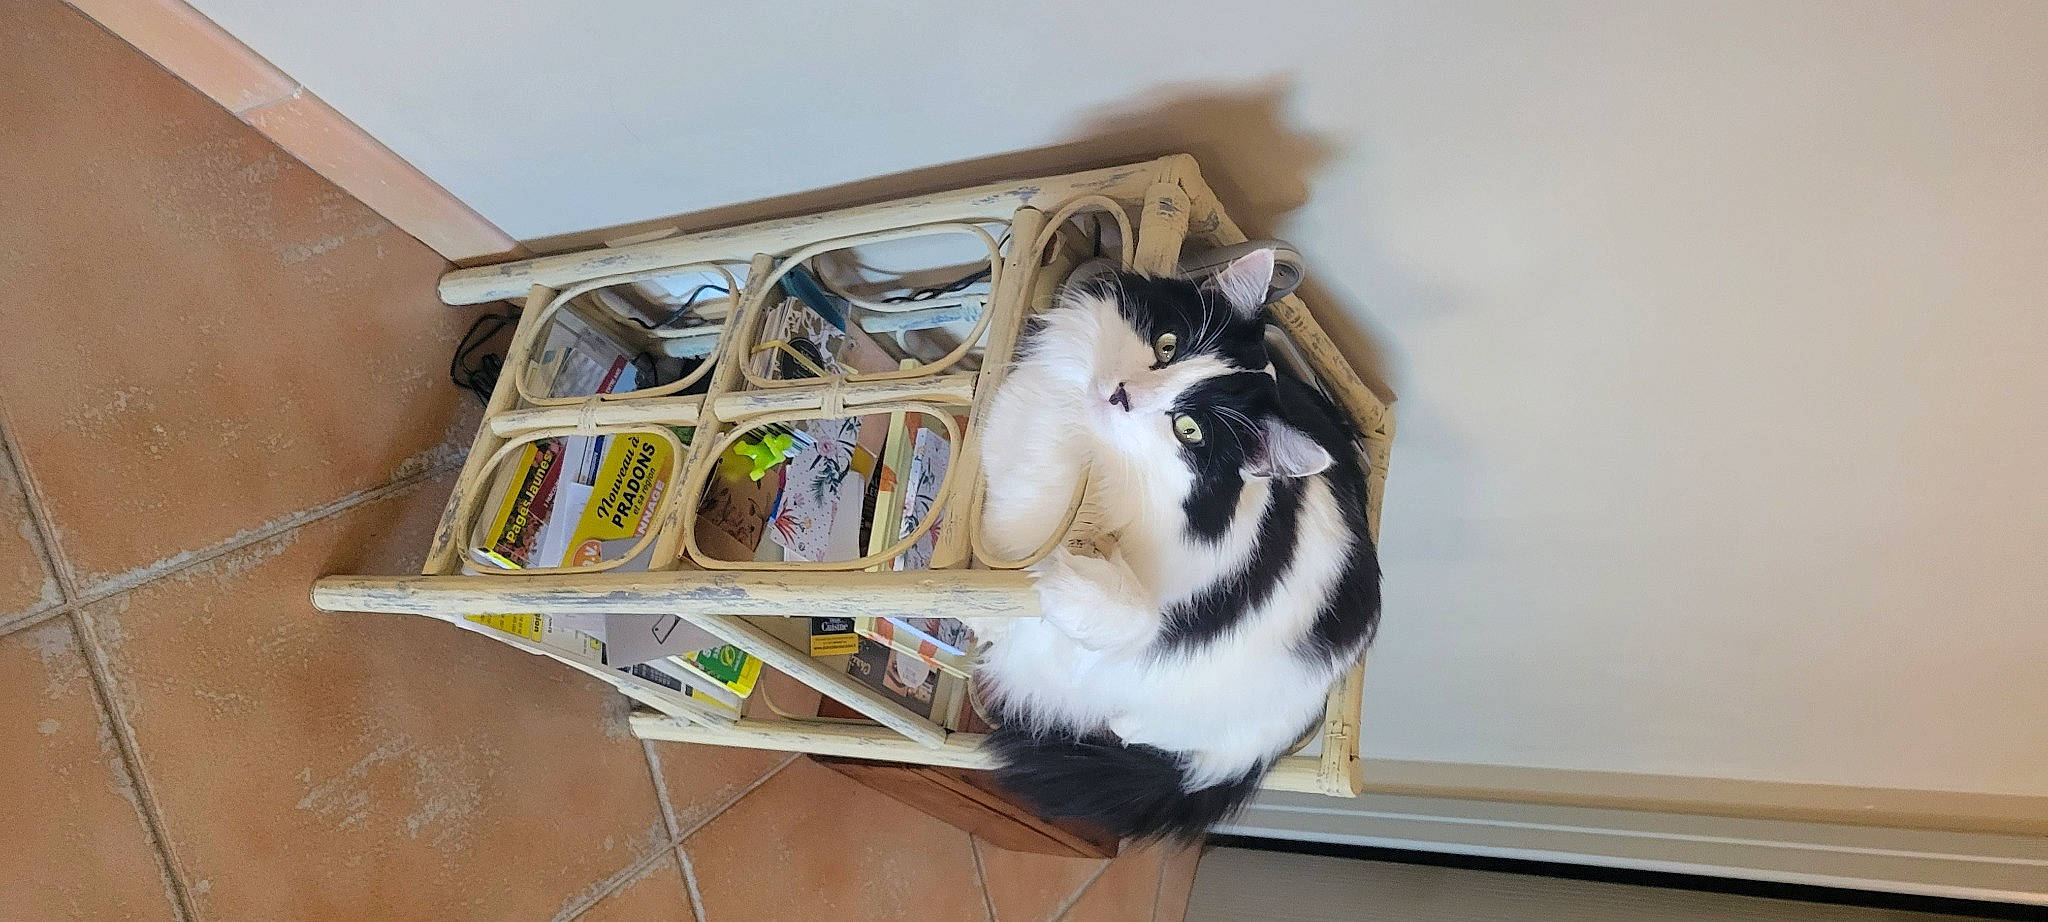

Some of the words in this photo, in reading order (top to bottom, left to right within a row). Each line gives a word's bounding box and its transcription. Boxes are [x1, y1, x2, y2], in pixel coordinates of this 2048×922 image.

[597, 449, 636, 519] Nouveau
[628, 436, 640, 448] à
[610, 442, 656, 530] PRADONS
[636, 480, 665, 536] NNAGE
[821, 621, 849, 632] Cuisine
